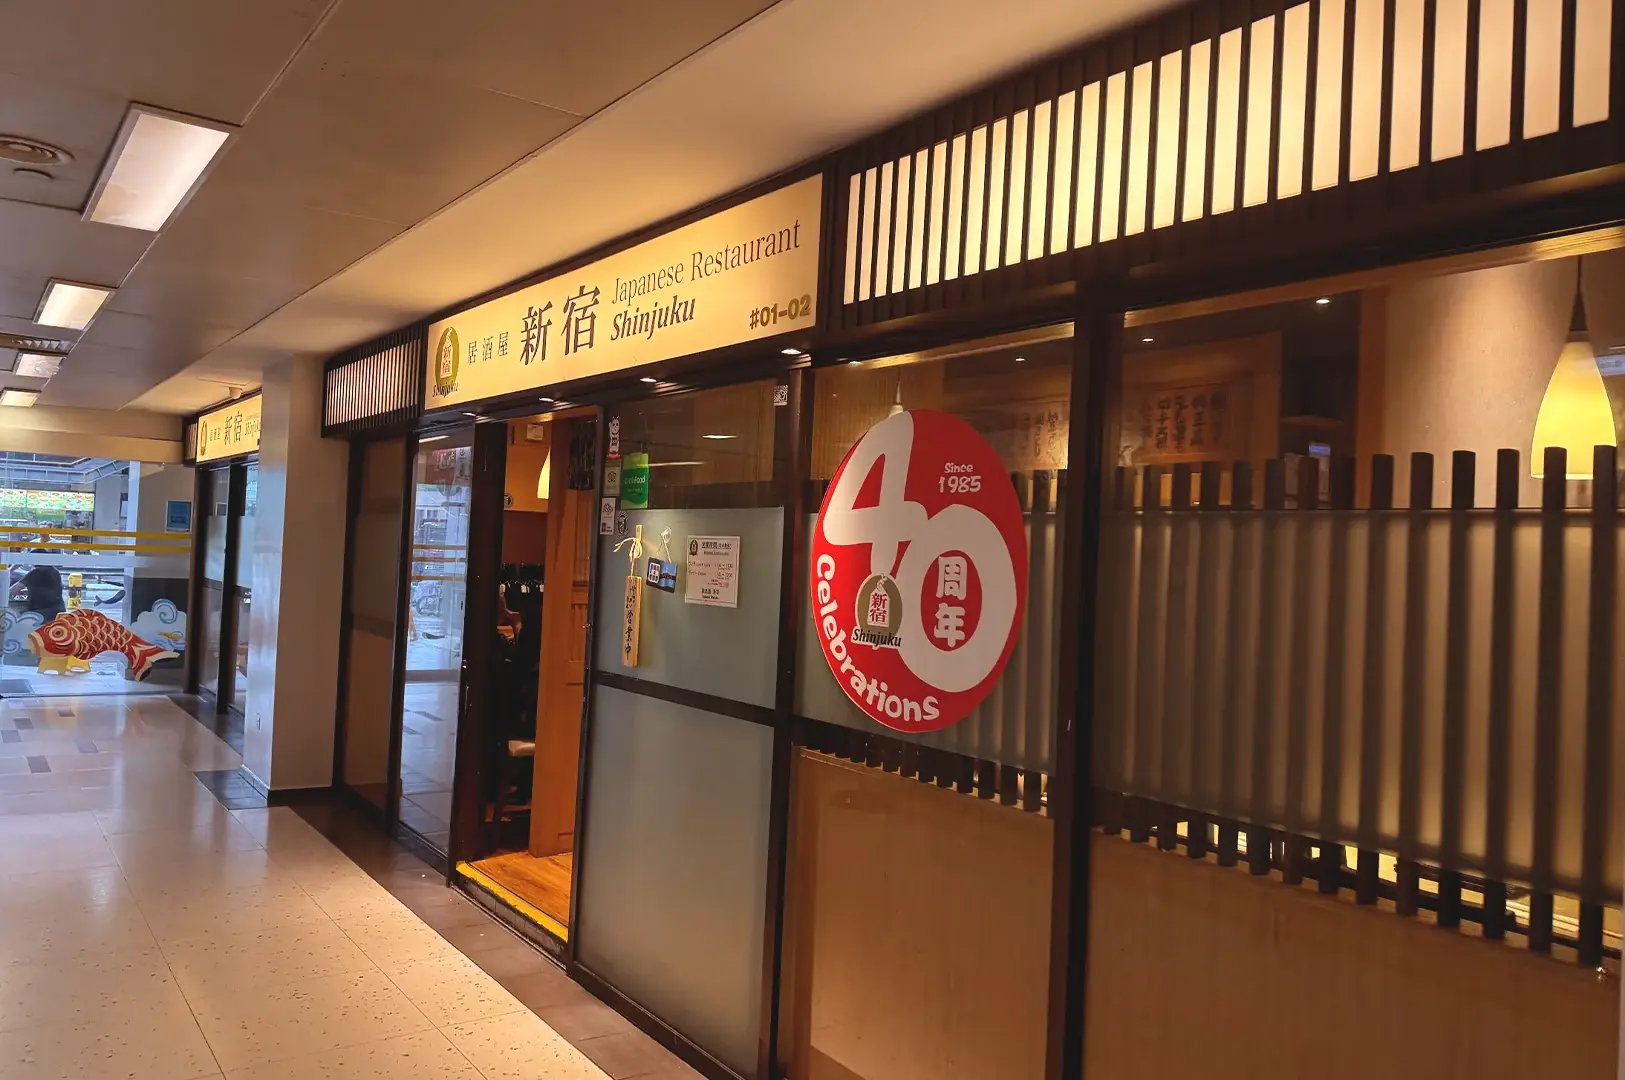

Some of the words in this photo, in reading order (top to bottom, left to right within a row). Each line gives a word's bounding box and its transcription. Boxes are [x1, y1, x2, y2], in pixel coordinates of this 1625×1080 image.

[612, 262, 684, 306] Japanese
[691, 219, 800, 281] Restaurant
[519, 285, 601, 366] 新宿
[610, 295, 696, 341] Shinjuku
[749, 294, 812, 330] #01-02
[467, 331, 509, 365] 居酒屋
[938, 475, 982, 493] 1985
[944, 462, 974, 473] Since
[822, 410, 1018, 693] 40
[869, 593, 887, 623] 新宿
[934, 555, 969, 648] 周年
[816, 553, 940, 722] Celebrations
[852, 628, 902, 647] Shinjuku
